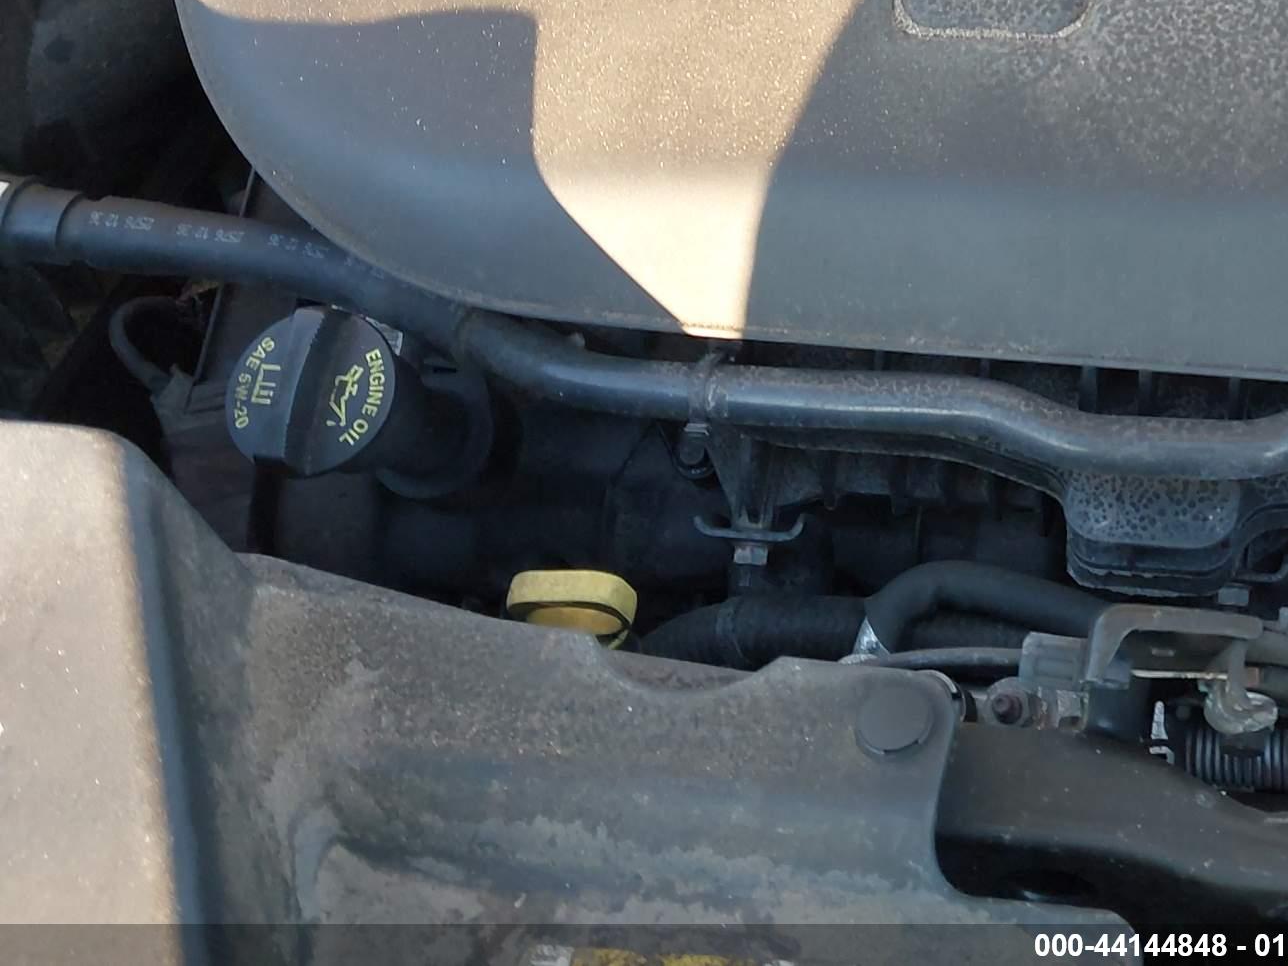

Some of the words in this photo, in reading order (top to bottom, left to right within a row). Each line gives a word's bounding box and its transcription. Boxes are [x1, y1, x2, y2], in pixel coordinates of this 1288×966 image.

[246, 337, 275, 371] SAE
[234, 373, 252, 429] 5W-20
[365, 348, 385, 417] ENGINE
[339, 419, 369, 446] OIL
